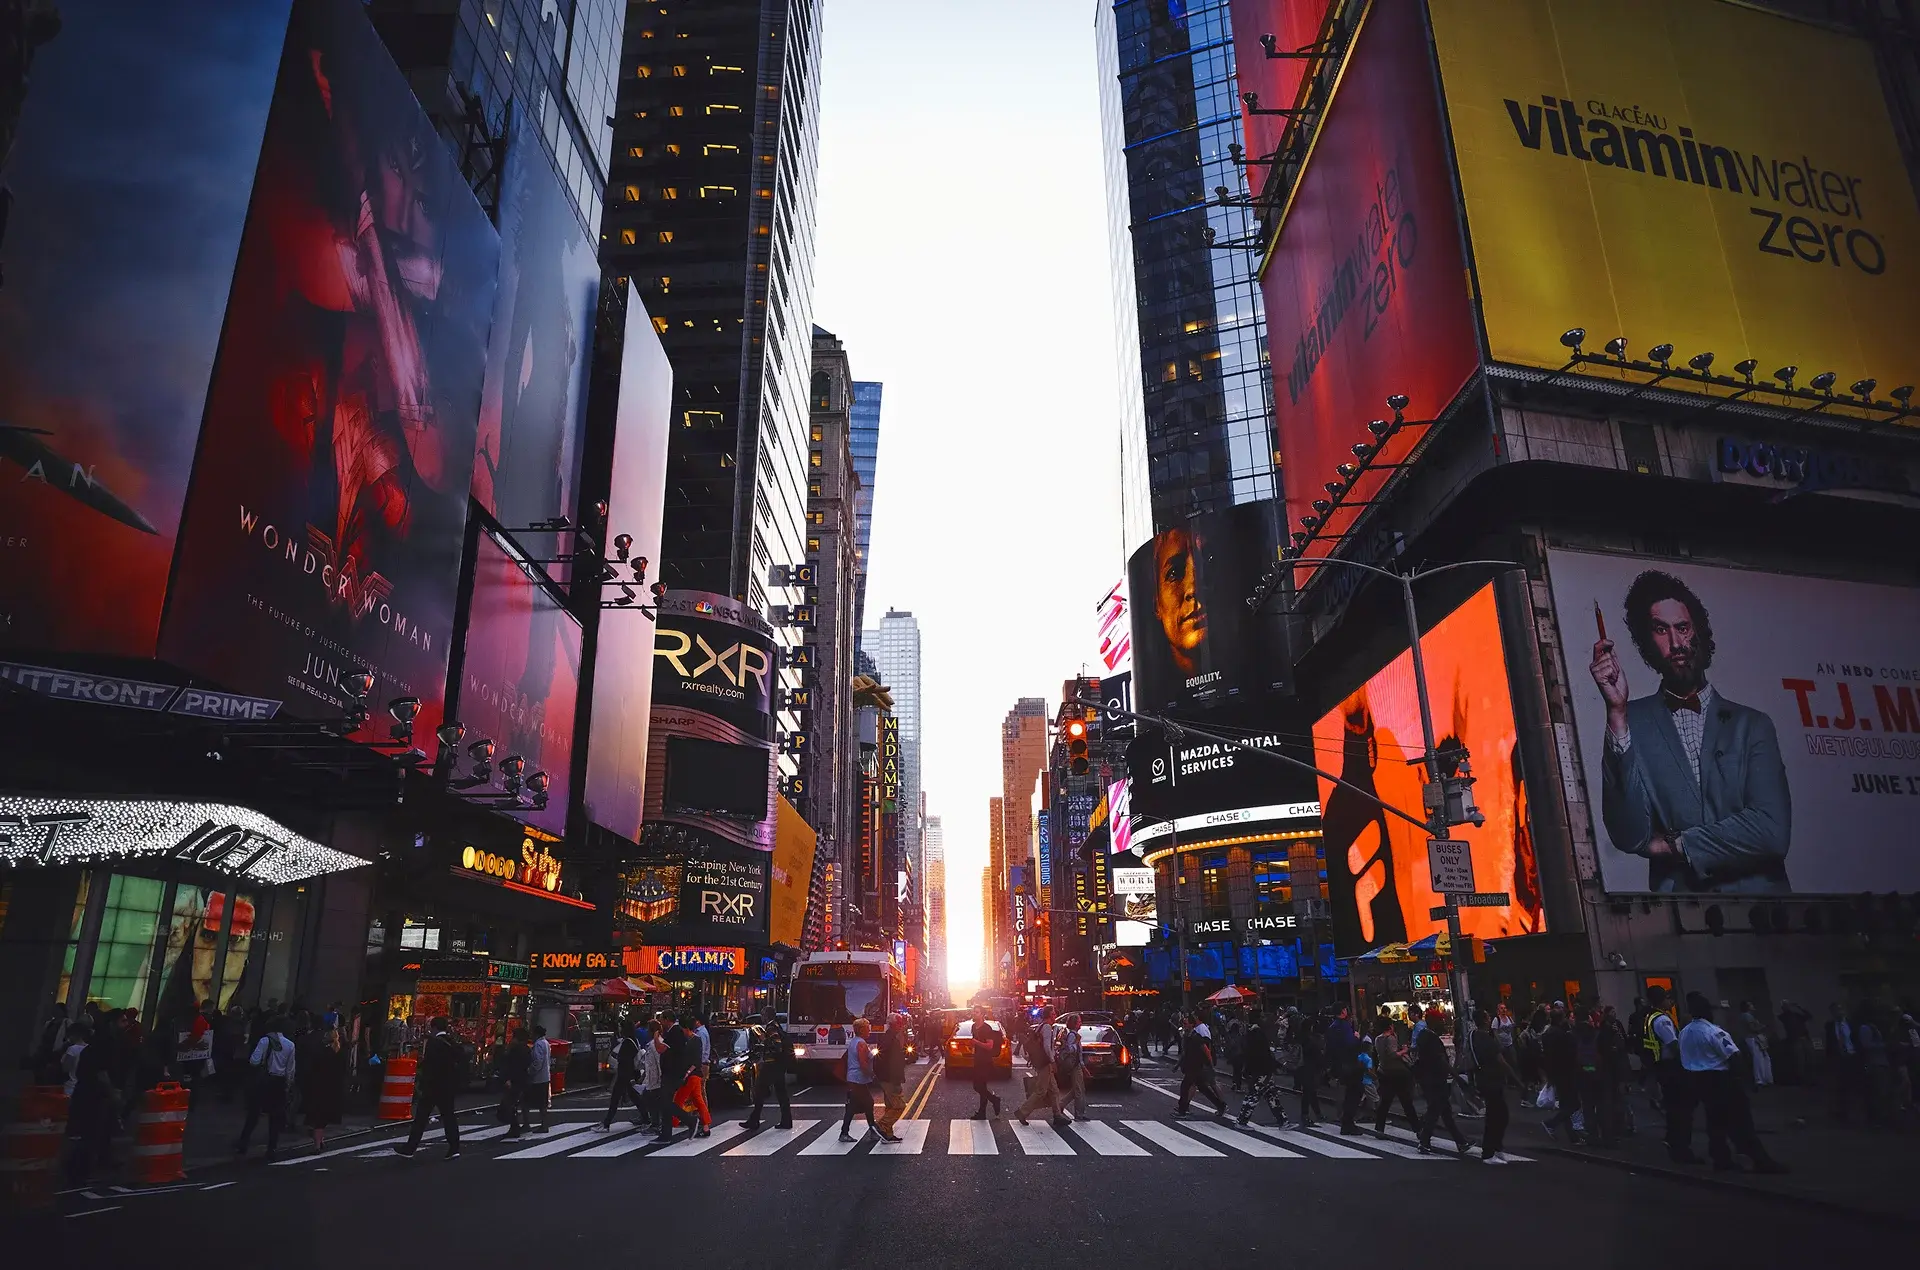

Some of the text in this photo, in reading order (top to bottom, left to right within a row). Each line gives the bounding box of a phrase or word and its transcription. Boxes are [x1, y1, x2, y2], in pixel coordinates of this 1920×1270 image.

[1503, 95, 1862, 219] vitaminwater
[1750, 207, 1886, 275] zero
[1364, 212, 1417, 342] zero
[0, 456, 96, 489] AN
[0, 536, 28, 547] ER
[240, 504, 432, 652] WONDER WOMAN
[247, 594, 263, 610] THE
[268, 606, 301, 631] FUTURE
[305, 627, 315, 637] OF
[320, 635, 350, 658] JUSTICE
[303, 652, 345, 687] JUN
[654, 628, 767, 697] RXR
[1817, 663, 1835, 675] AN
[1841, 664, 1873, 677] HBO
[793, 568, 811, 794] CHAMPS
[1185, 671, 1222, 688] EQUALITY.
[681, 681, 745, 700] rxrrealty.com
[185, 694, 270, 720] PRIME
[470, 674, 569, 752] WONDER WOMAN
[1781, 678, 1872, 731] T.J.
[650, 716, 696, 727] SHARP
[883, 717, 897, 799] MADAME
[1180, 743, 1221, 762] MAZDA
[1181, 756, 1234, 775] SERVICES
[1851, 773, 1903, 795] JUNE
[1206, 812, 1240, 824] CHASE
[175, 819, 287, 874] LOFT
[1436, 845, 1462, 854] BUSES
[728, 859, 747, 873] New
[746, 863, 762, 876] York
[1440, 856, 1460, 865] ONLY
[686, 873, 763, 892] for the 21st Century
[700, 890, 754, 917] RXR
[1469, 895, 1507, 906] Broadway
[712, 915, 746, 924] REALTY
[1097, 901, 1108, 924] NW
[1015, 895, 1026, 957] REGAL
[1194, 920, 1230, 933] CHASE
[1248, 916, 1297, 931] CHASE
[543, 953, 582, 968] KNOW
[658, 950, 736, 969] CHAMPS
[1415, 975, 1439, 988] SODA
